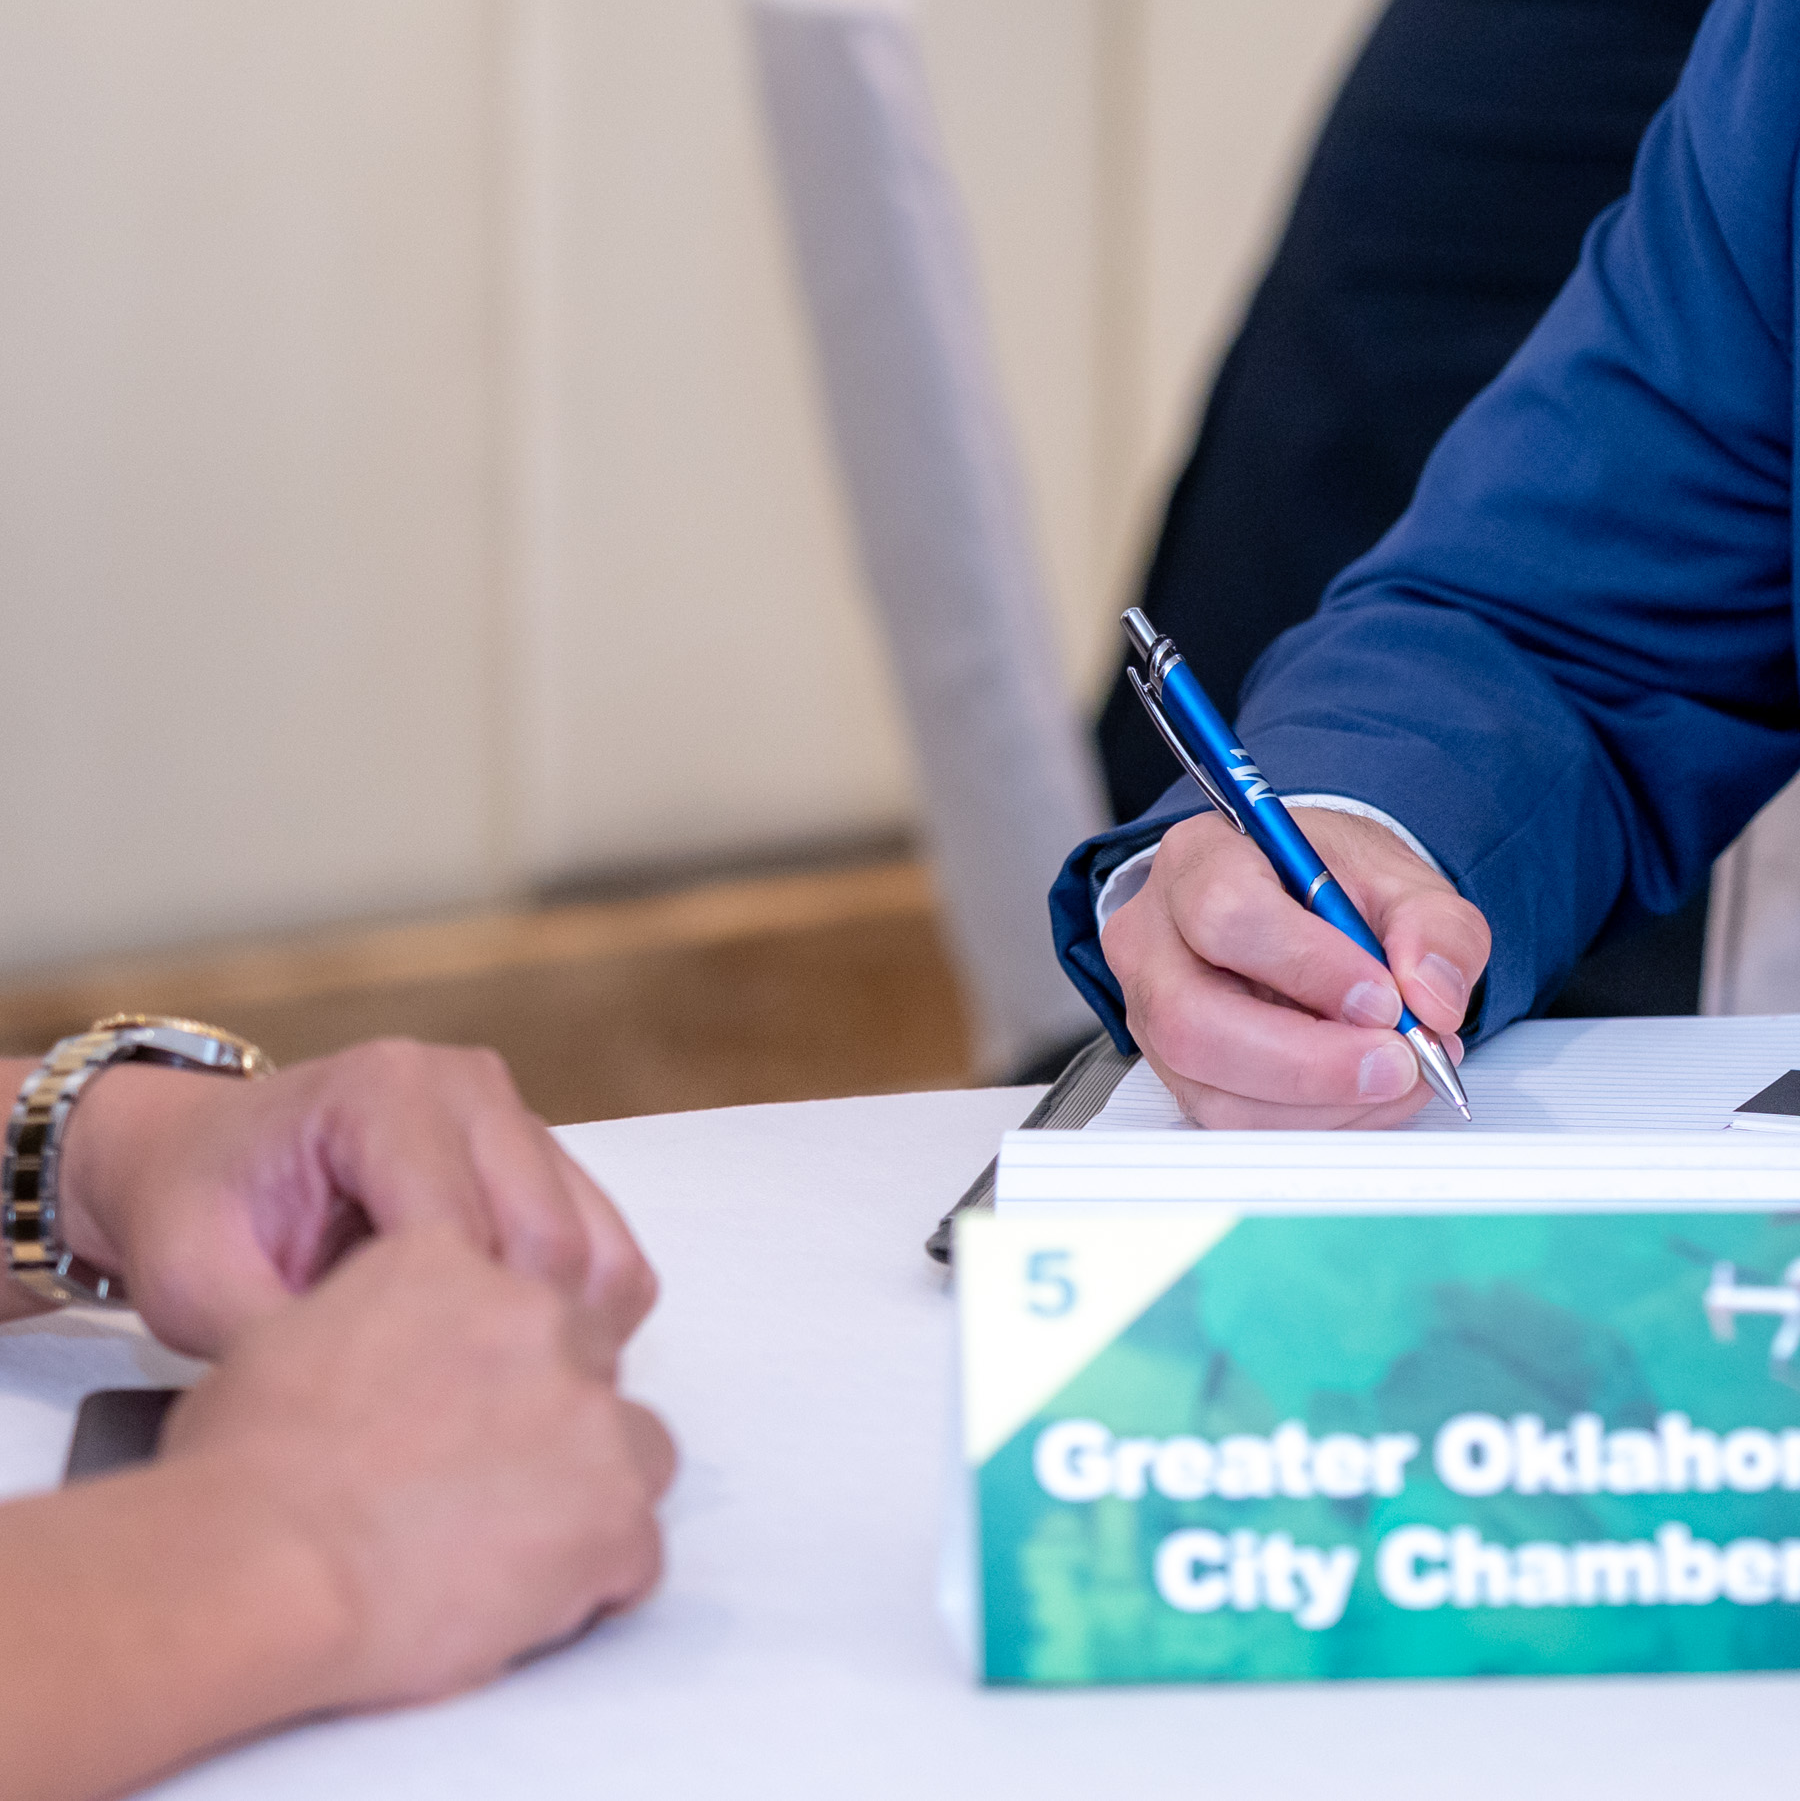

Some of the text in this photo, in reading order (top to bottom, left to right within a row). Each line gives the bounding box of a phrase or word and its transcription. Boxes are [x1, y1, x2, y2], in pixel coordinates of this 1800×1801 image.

[1025, 1249, 1077, 1319] 5
[1035, 1419, 1418, 1503] Greater
[1156, 1529, 1360, 1631] City
